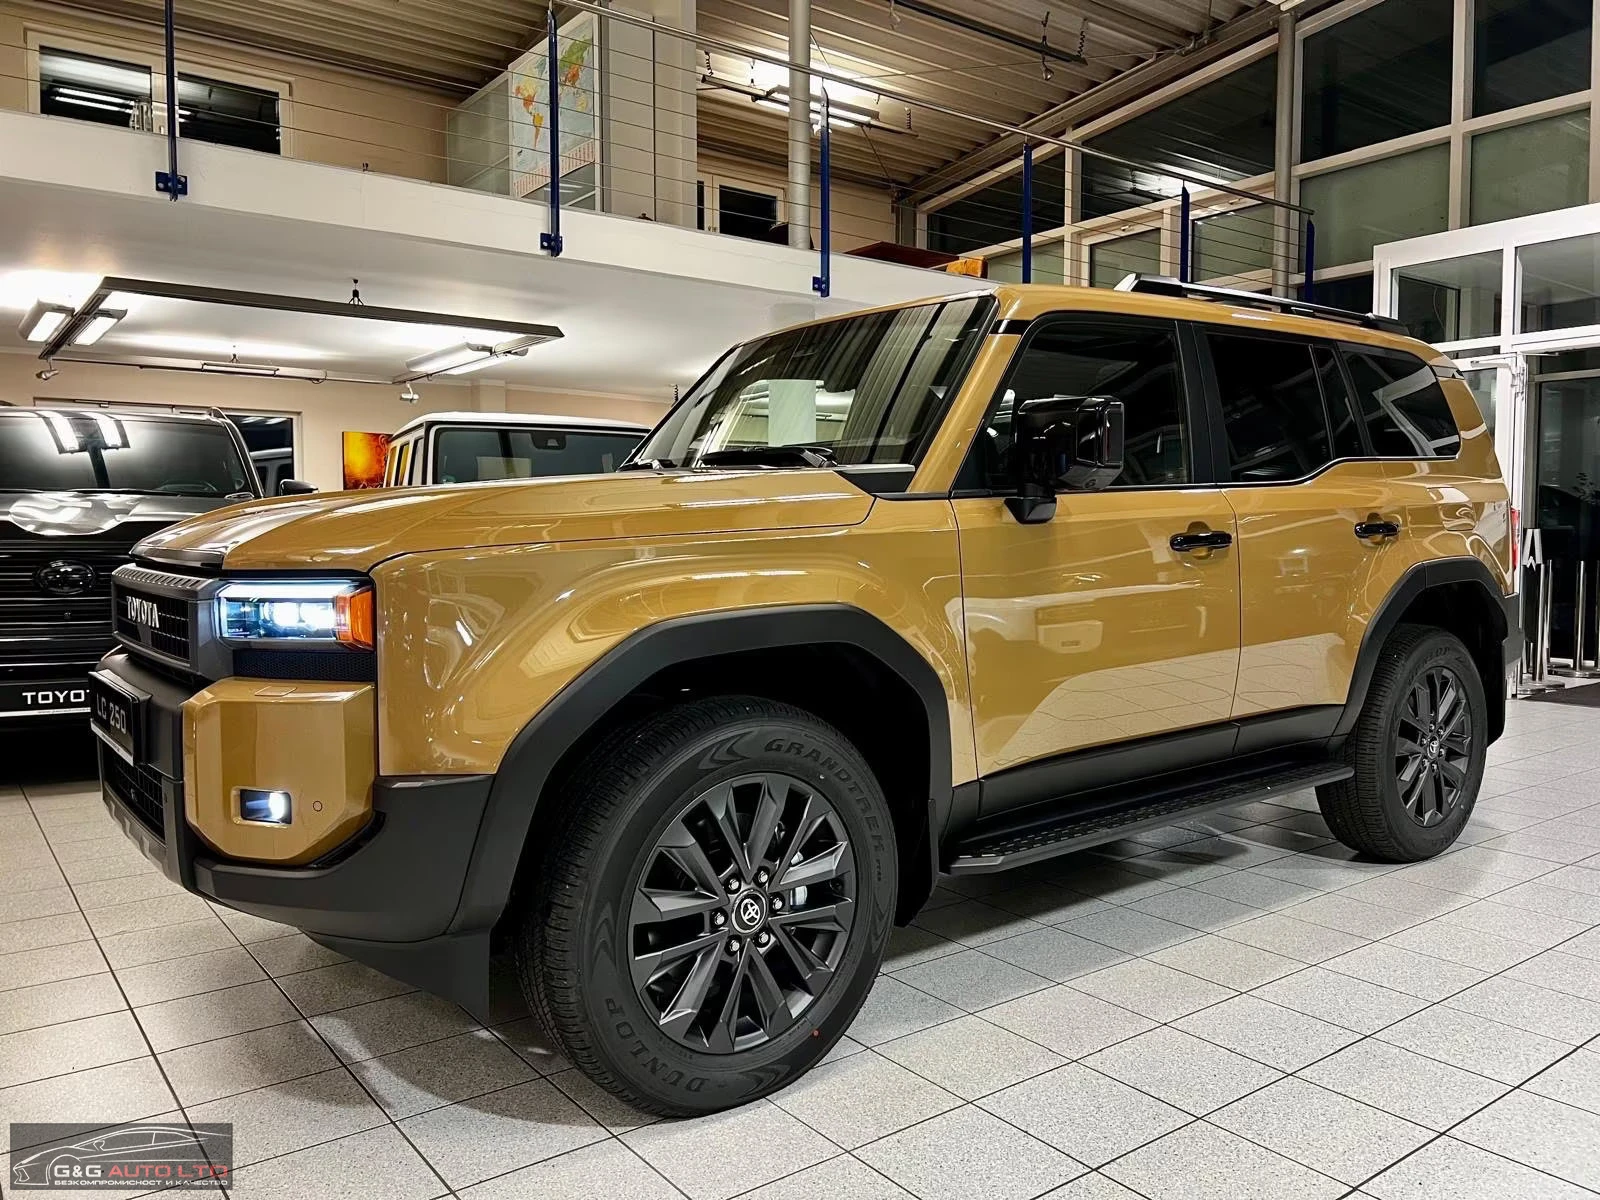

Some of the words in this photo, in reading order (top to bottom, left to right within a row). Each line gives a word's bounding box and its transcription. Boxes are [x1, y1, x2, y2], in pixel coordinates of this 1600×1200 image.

[126, 596, 160, 628] TOYOTA
[22, 689, 90, 705] TOYO
[96, 692, 107, 720] LC
[109, 702, 127, 735] 250
[605, 998, 711, 1093] DUNLOP
